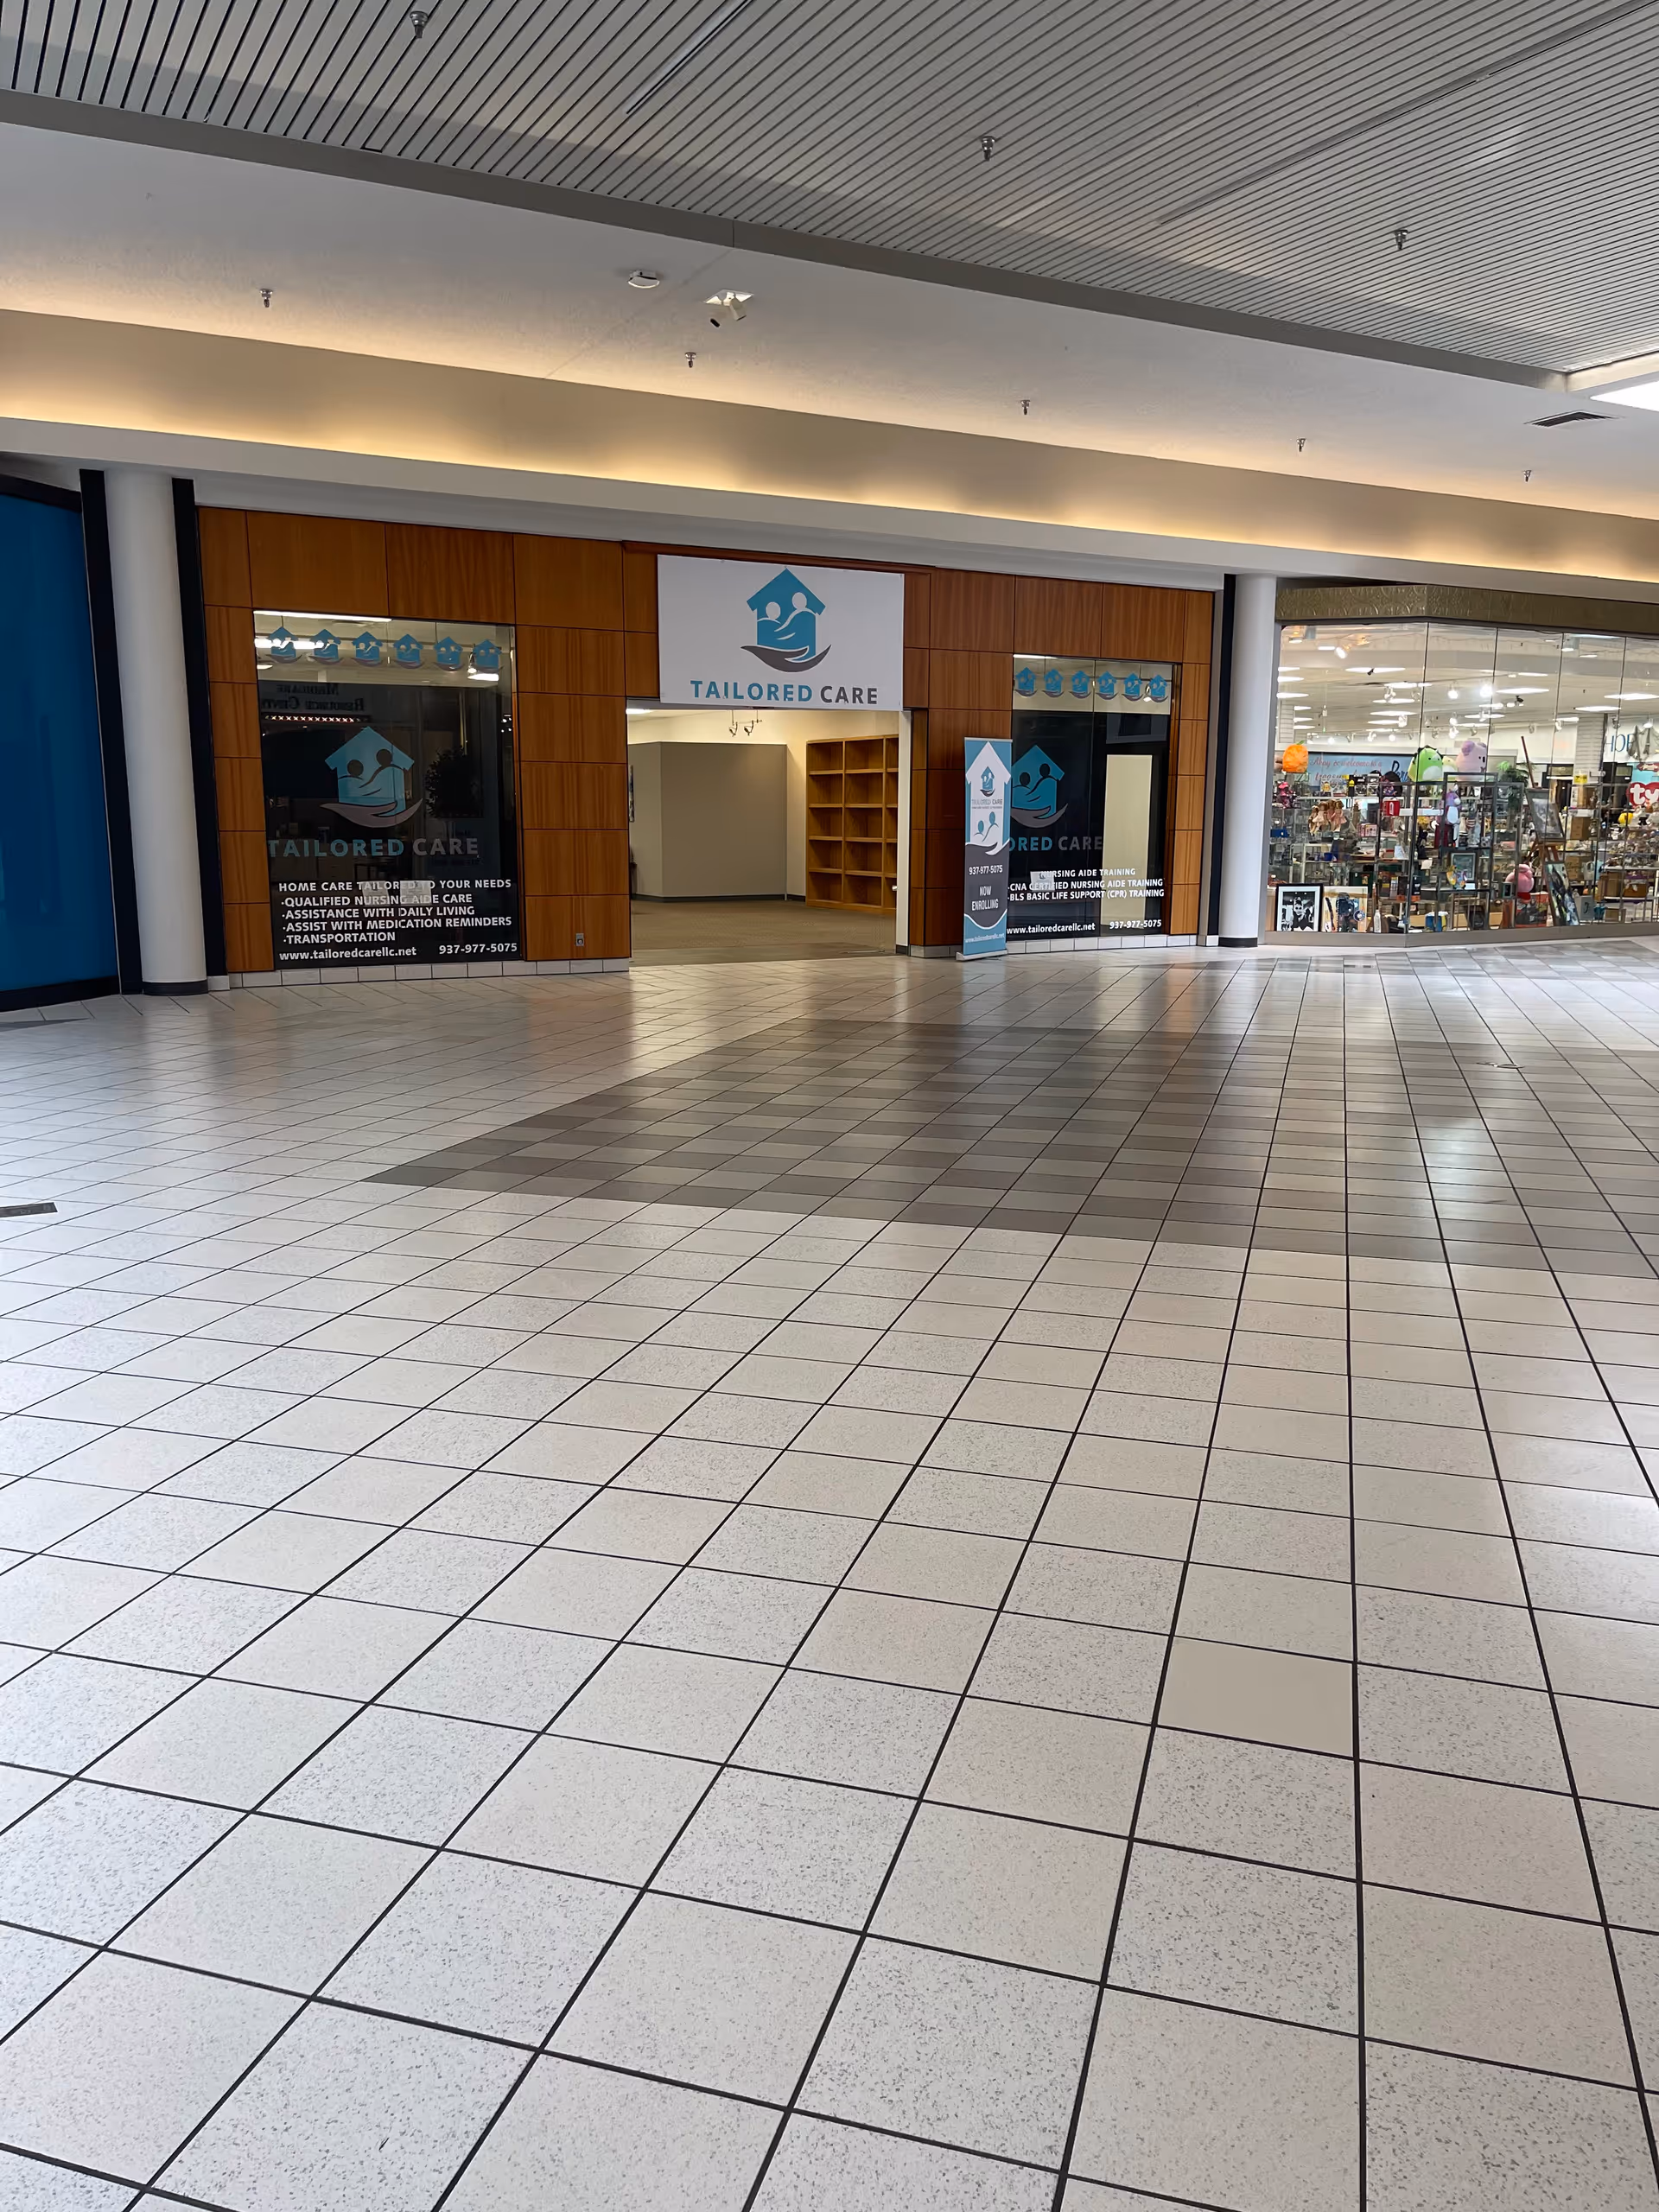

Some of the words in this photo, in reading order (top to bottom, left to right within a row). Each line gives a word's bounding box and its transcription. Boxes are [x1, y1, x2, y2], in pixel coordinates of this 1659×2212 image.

[690, 681, 812, 702] TAILORED
[821, 686, 877, 704] CARE
[268, 839, 404, 857] TAILORED
[413, 838, 479, 855] CARE
[1058, 836, 1102, 850] CARE
[969, 865, 1002, 874] 937-977-5075
[279, 883, 316, 892] HOME
[357, 881, 415, 890] TAILORED
[440, 880, 470, 889] YOUR
[475, 880, 512, 888] NEEDS
[1029, 881, 1068, 890] CERTIFIED
[1071, 880, 1104, 889] NURSING
[980, 887, 991, 896] NOW
[1027, 892, 1049, 900] BASIC
[1052, 891, 1067, 899] LIFE
[1070, 890, 1105, 899] SUPPORT
[1107, 890, 1126, 899] (CPR)
[355, 895, 407, 906] NURSING
[412, 895, 439, 904] AIDE
[442, 894, 472, 903] CARE
[972, 899, 998, 911] ENROLLING
[363, 907, 394, 918] WITH
[398, 907, 433, 916] DAILY
[436, 906, 475, 916] LIVING
[331, 921, 362, 930] WITH
[366, 918, 442, 930] MEDICATION
[446, 917, 512, 926] REMINDERS
[1007, 923, 1095, 934] www.tailoredcarellc.net
[1109, 920, 1161, 929] 937-977-5075
[280, 947, 416, 961] www.tailoredcarellc.net
[439, 944, 517, 954] 937-977-5075
